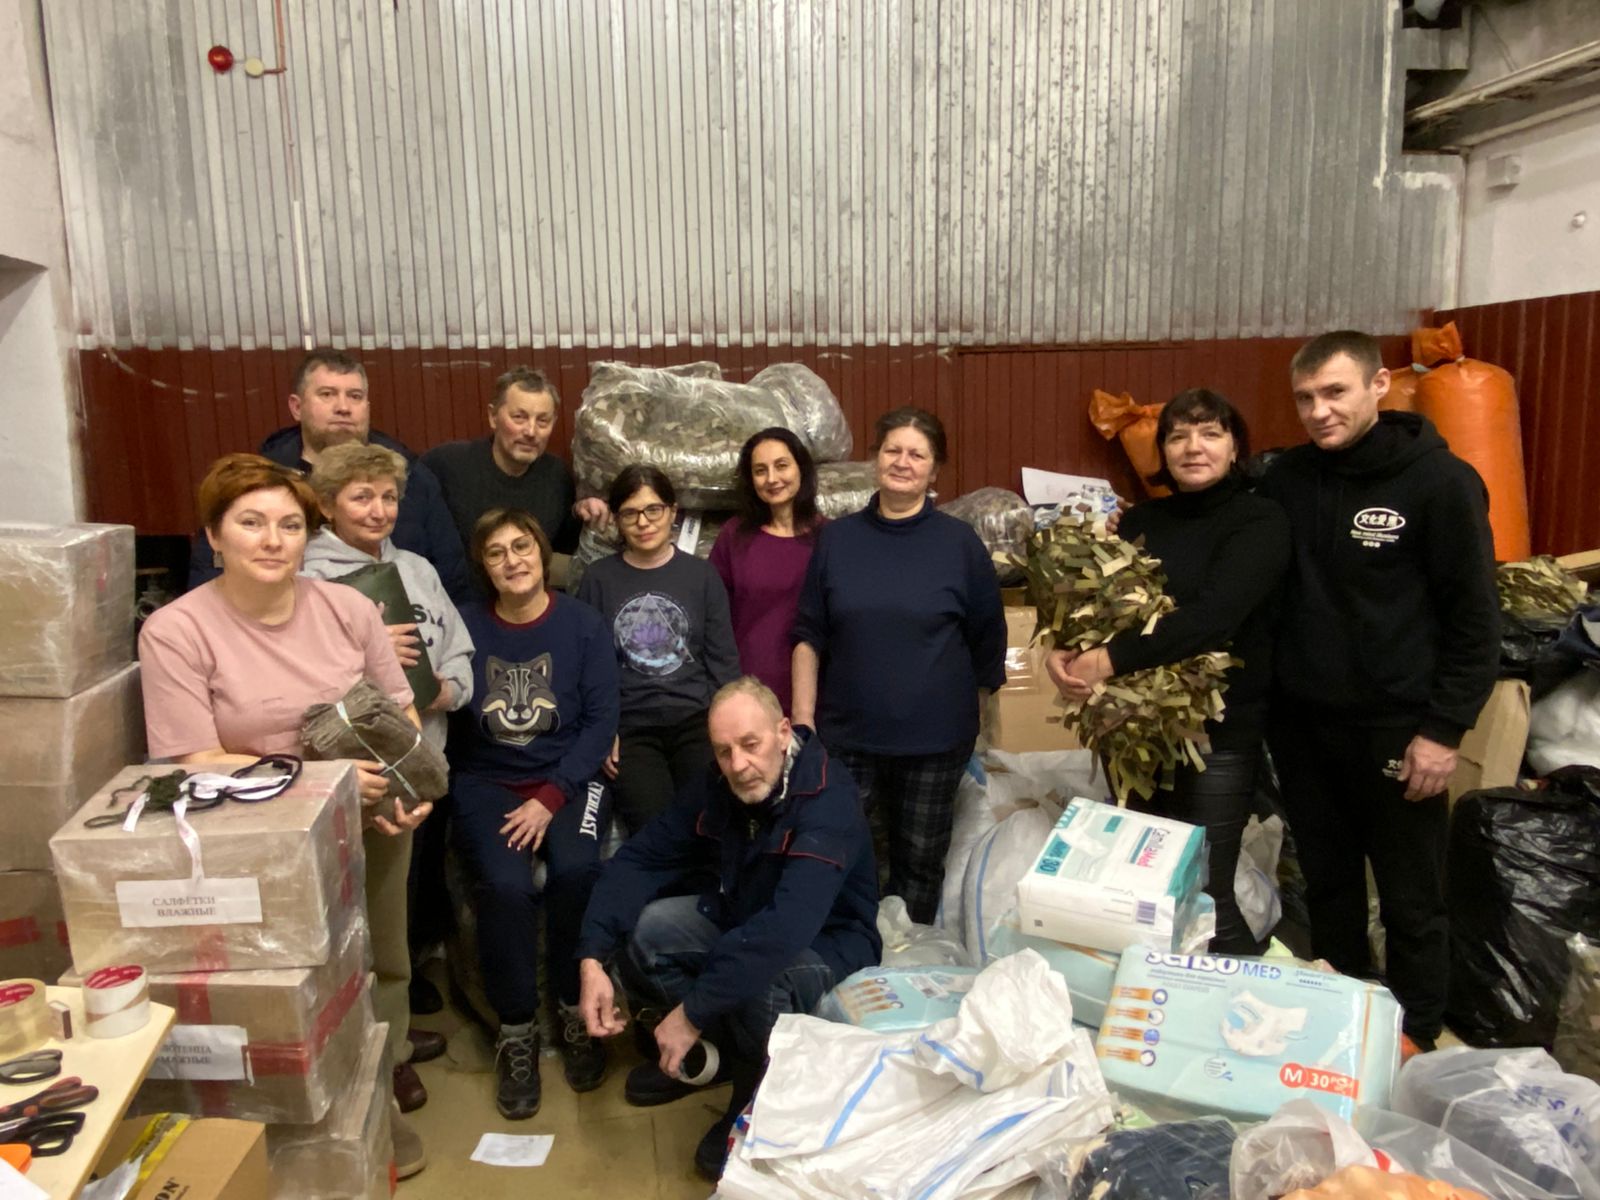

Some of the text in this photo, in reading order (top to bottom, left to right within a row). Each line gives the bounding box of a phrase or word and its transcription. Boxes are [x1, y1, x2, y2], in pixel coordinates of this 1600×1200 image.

[152, 896, 216, 906] САЛФЕТКИ
[157, 907, 216, 917] ВЛАЖНЫЕ
[1242, 962, 1282, 980] MED
[156, 1055, 212, 1066] МАЖНЫЕ
[1284, 1067, 1303, 1083] M
[1310, 1072, 1329, 1088] 30
